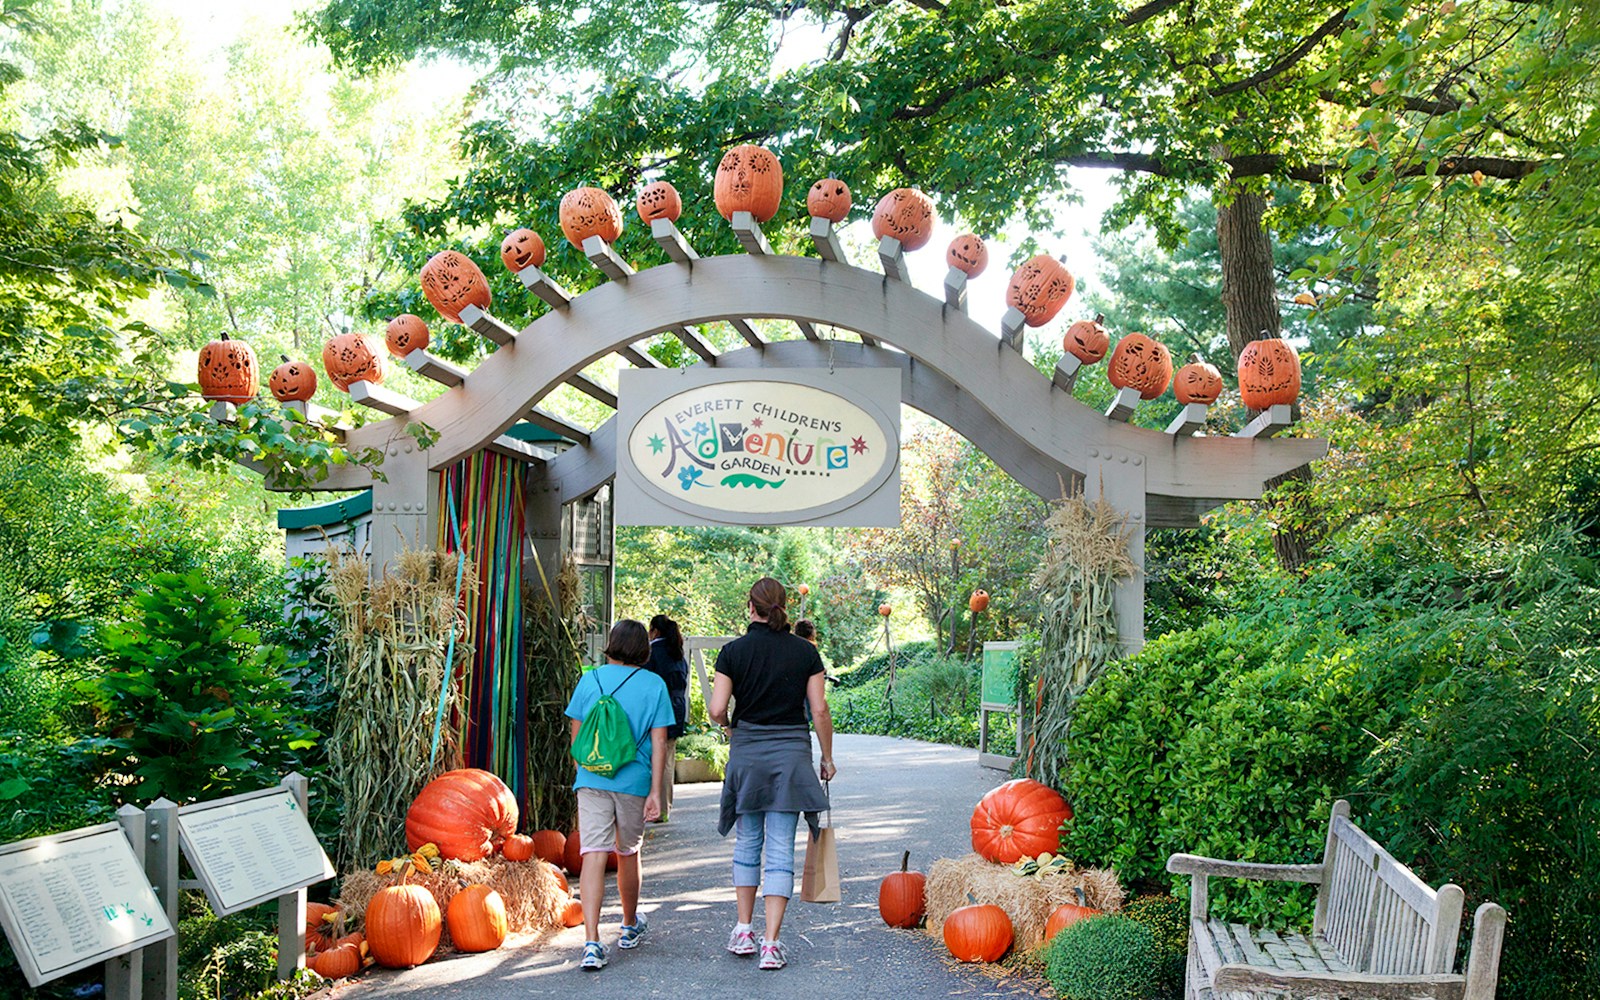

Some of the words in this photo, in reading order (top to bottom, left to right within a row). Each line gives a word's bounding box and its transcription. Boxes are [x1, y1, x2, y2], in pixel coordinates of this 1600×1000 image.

[675, 399, 743, 424] EVERETT
[753, 402, 842, 433] CHILDREN'S
[720, 457, 780, 477] GARDEN
